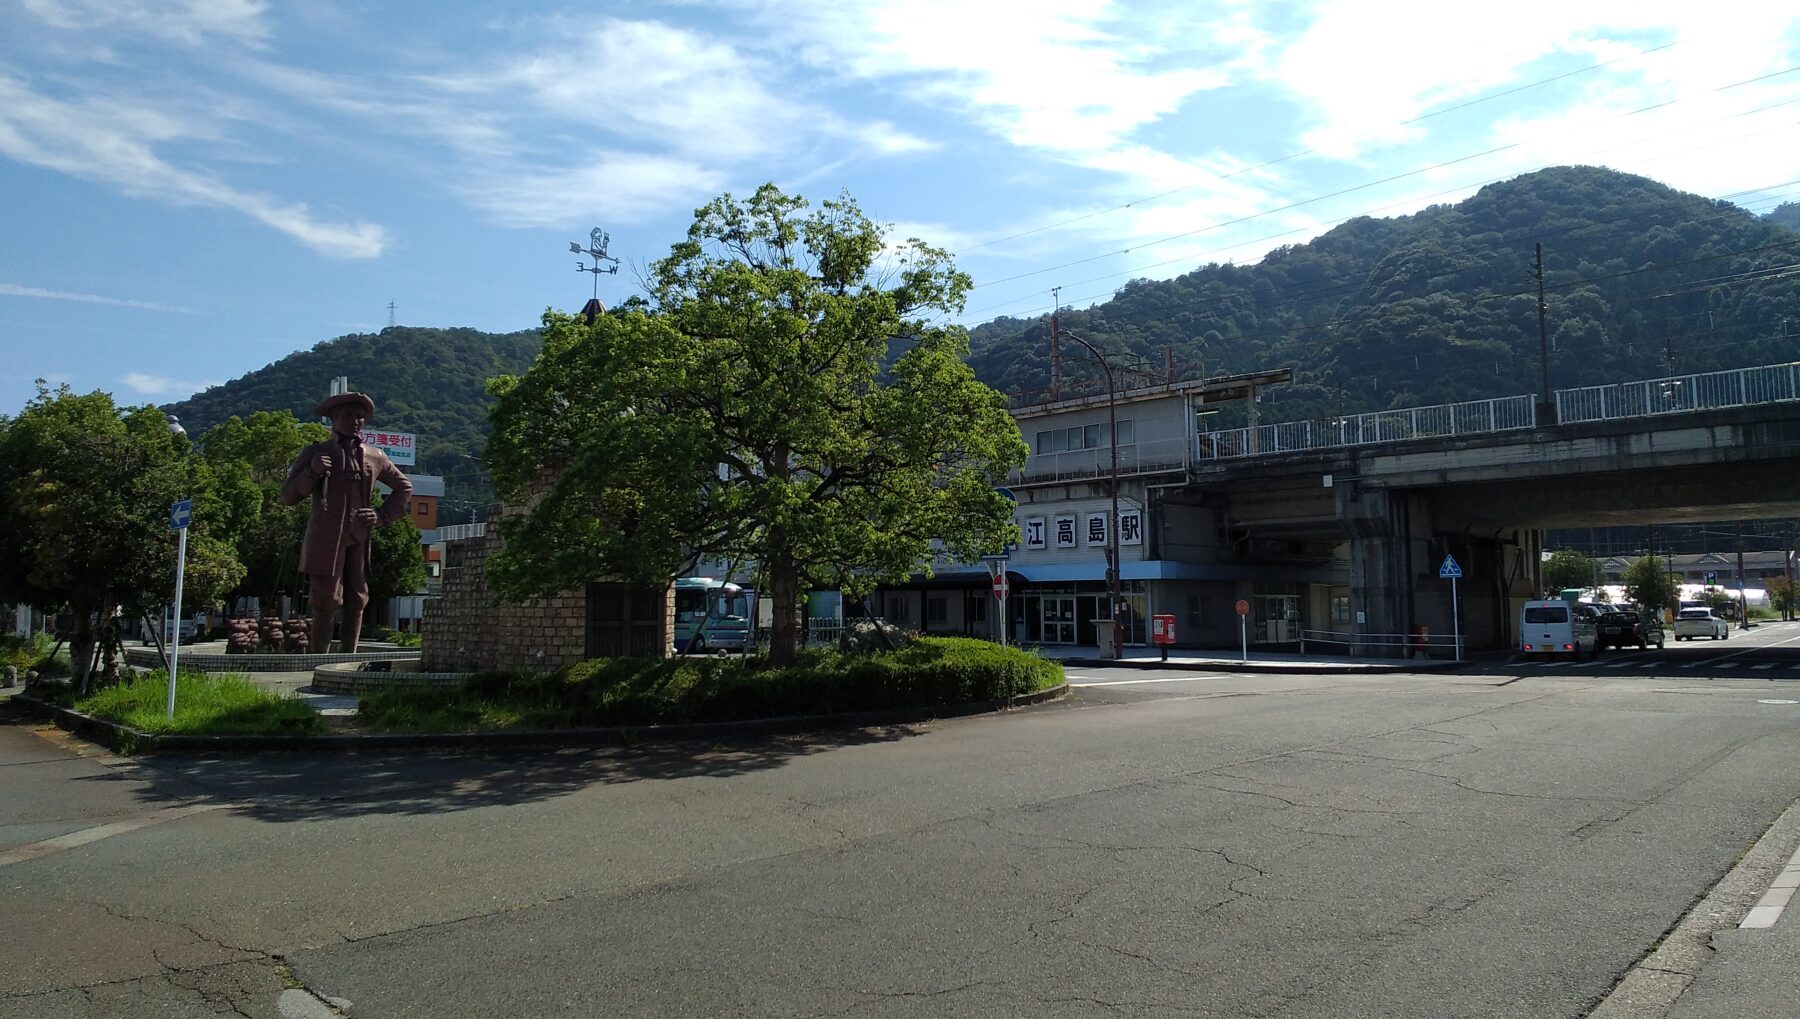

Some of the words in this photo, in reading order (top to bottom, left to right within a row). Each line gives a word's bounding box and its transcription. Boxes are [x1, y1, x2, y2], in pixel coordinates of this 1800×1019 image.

[608, 264, 618, 275] W
[360, 432, 412, 448] 方箋受付
[1009, 515, 1140, 546] 江高島駅
